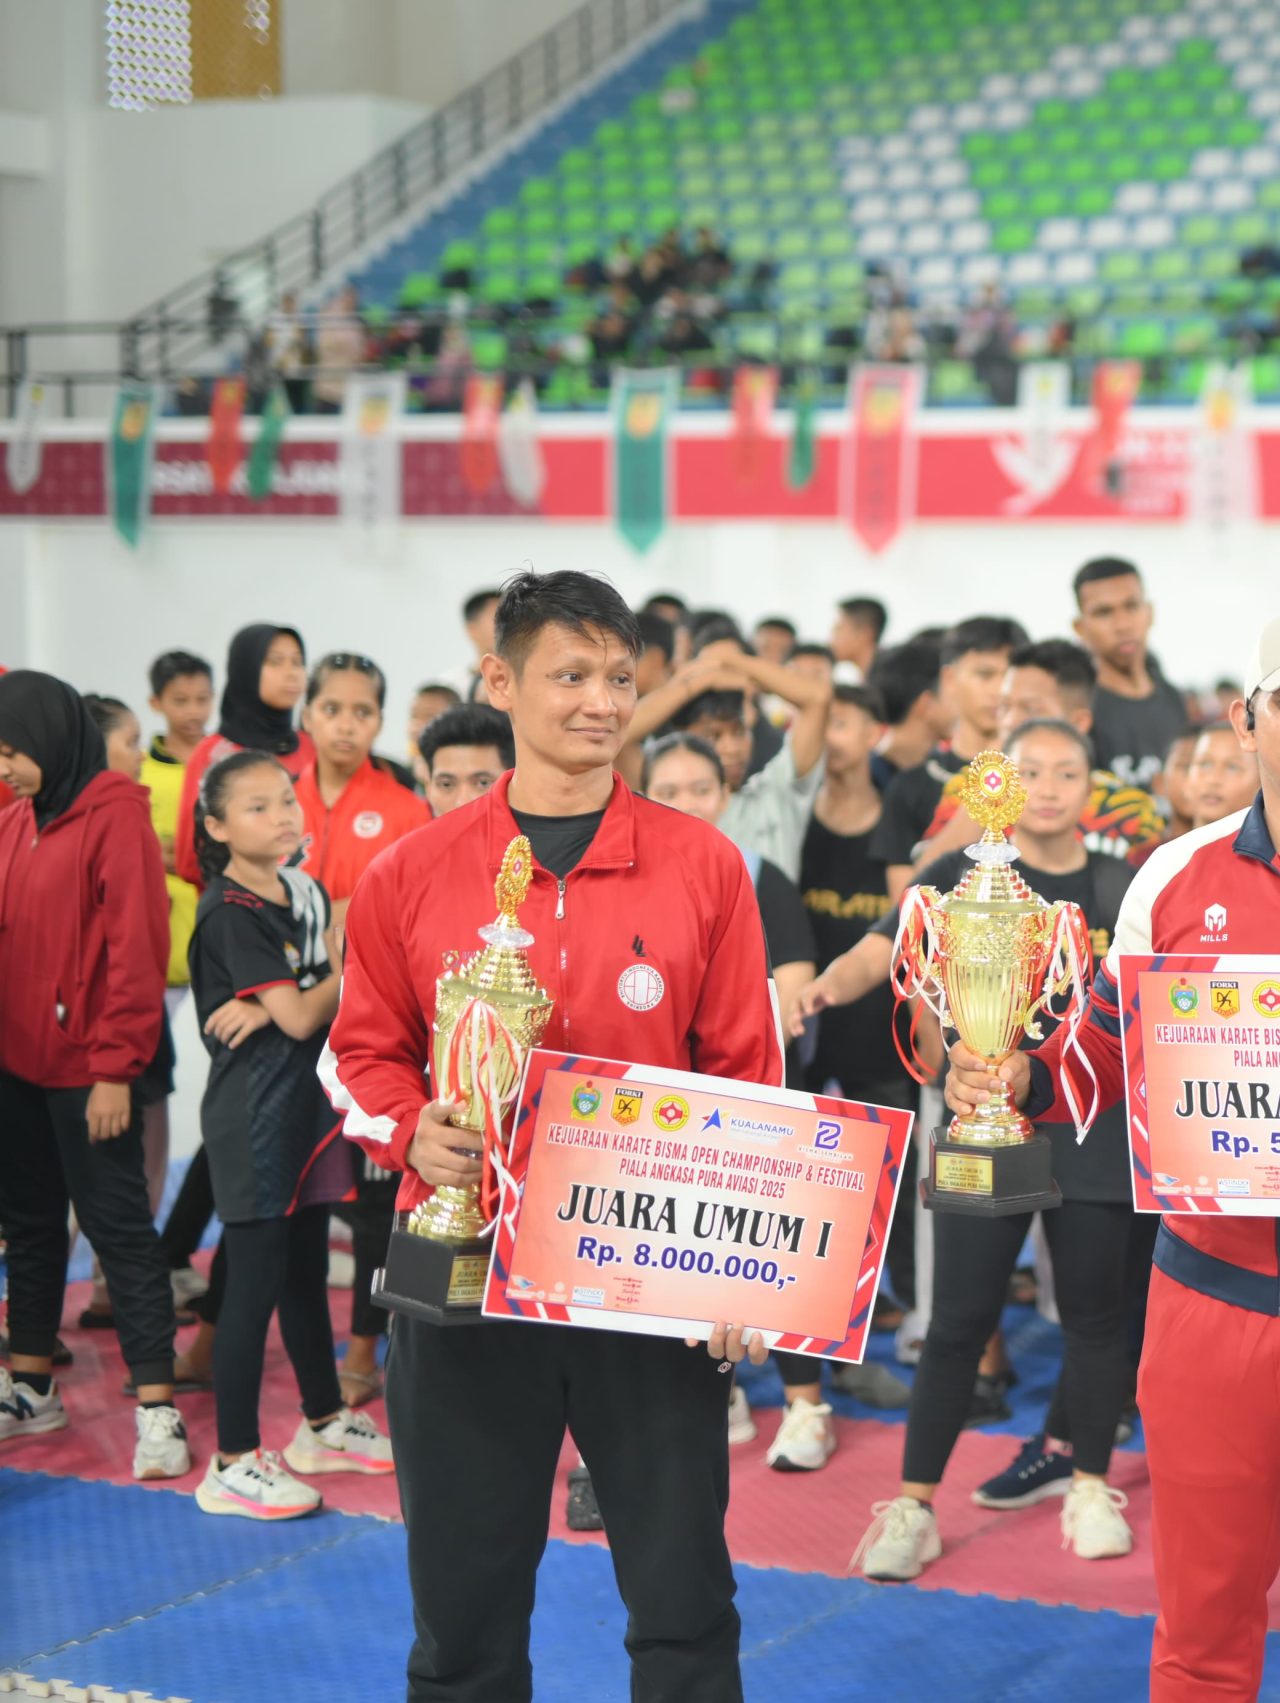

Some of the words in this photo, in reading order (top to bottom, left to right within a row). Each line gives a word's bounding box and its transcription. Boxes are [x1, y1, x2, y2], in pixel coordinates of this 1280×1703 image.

[1200, 934, 1228, 942] MILLS
[1156, 1025, 1216, 1043] KEJUARAAN
[1221, 1027, 1260, 1045] KARATE
[1233, 1050, 1262, 1067] PIALA
[617, 1088, 642, 1098] FORKI
[730, 1119, 794, 1136] KUALANAMU
[1211, 1130, 1259, 1158] Rp.
[548, 1125, 609, 1149] KEJUARAAN
[612, 1134, 652, 1155] KARATE
[655, 1141, 688, 1161] BISMA
[691, 1146, 719, 1165] OPEN
[722, 1150, 803, 1179] CHAMPIONSHIP
[805, 1165, 813, 1181] &
[817, 1167, 865, 1190] FESTIVAL
[619, 1158, 647, 1178] PIALA
[650, 1163, 695, 1184] ANGKASA
[697, 1170, 723, 1189] PURA
[725, 1174, 759, 1194] AVIASI
[760, 1179, 786, 1199] 2025
[557, 1183, 677, 1234] JUARA
[693, 1201, 805, 1253] UMUM
[815, 1221, 832, 1258] I
[576, 1236, 622, 1267] Rp.
[633, 1243, 796, 1290] 8.000.000,-
